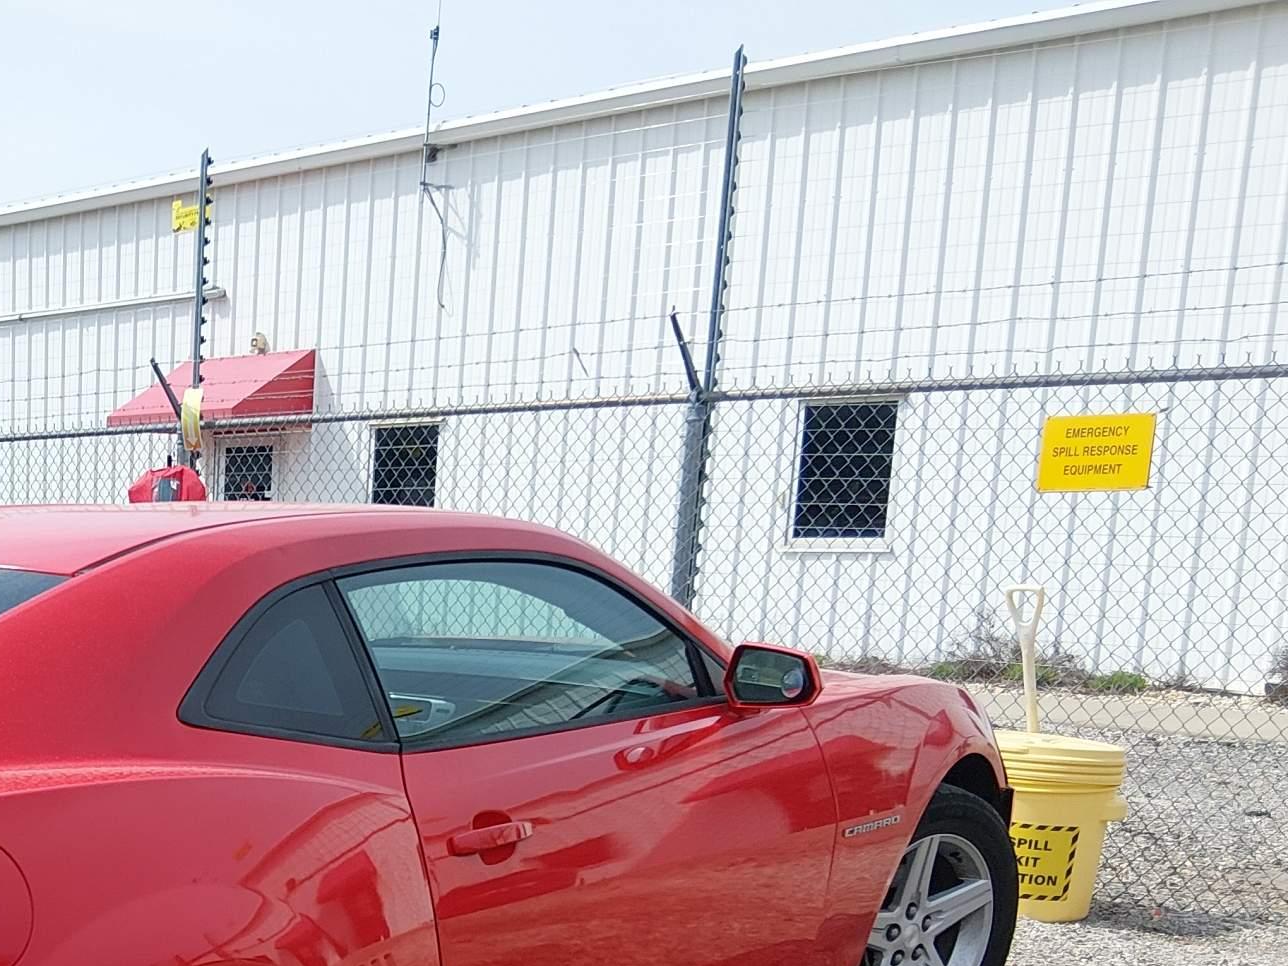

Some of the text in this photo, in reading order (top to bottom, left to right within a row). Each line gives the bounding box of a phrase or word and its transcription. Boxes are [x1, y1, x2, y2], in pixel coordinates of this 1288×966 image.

[1065, 426, 1130, 438] EMERGENCY
[1052, 444, 1138, 458] SPILL RESPONSE
[1063, 464, 1123, 475] EQUIPMENT
[844, 815, 901, 837] CAMARO
[1016, 855, 1041, 868] KIT
[1017, 873, 1058, 886] TION
